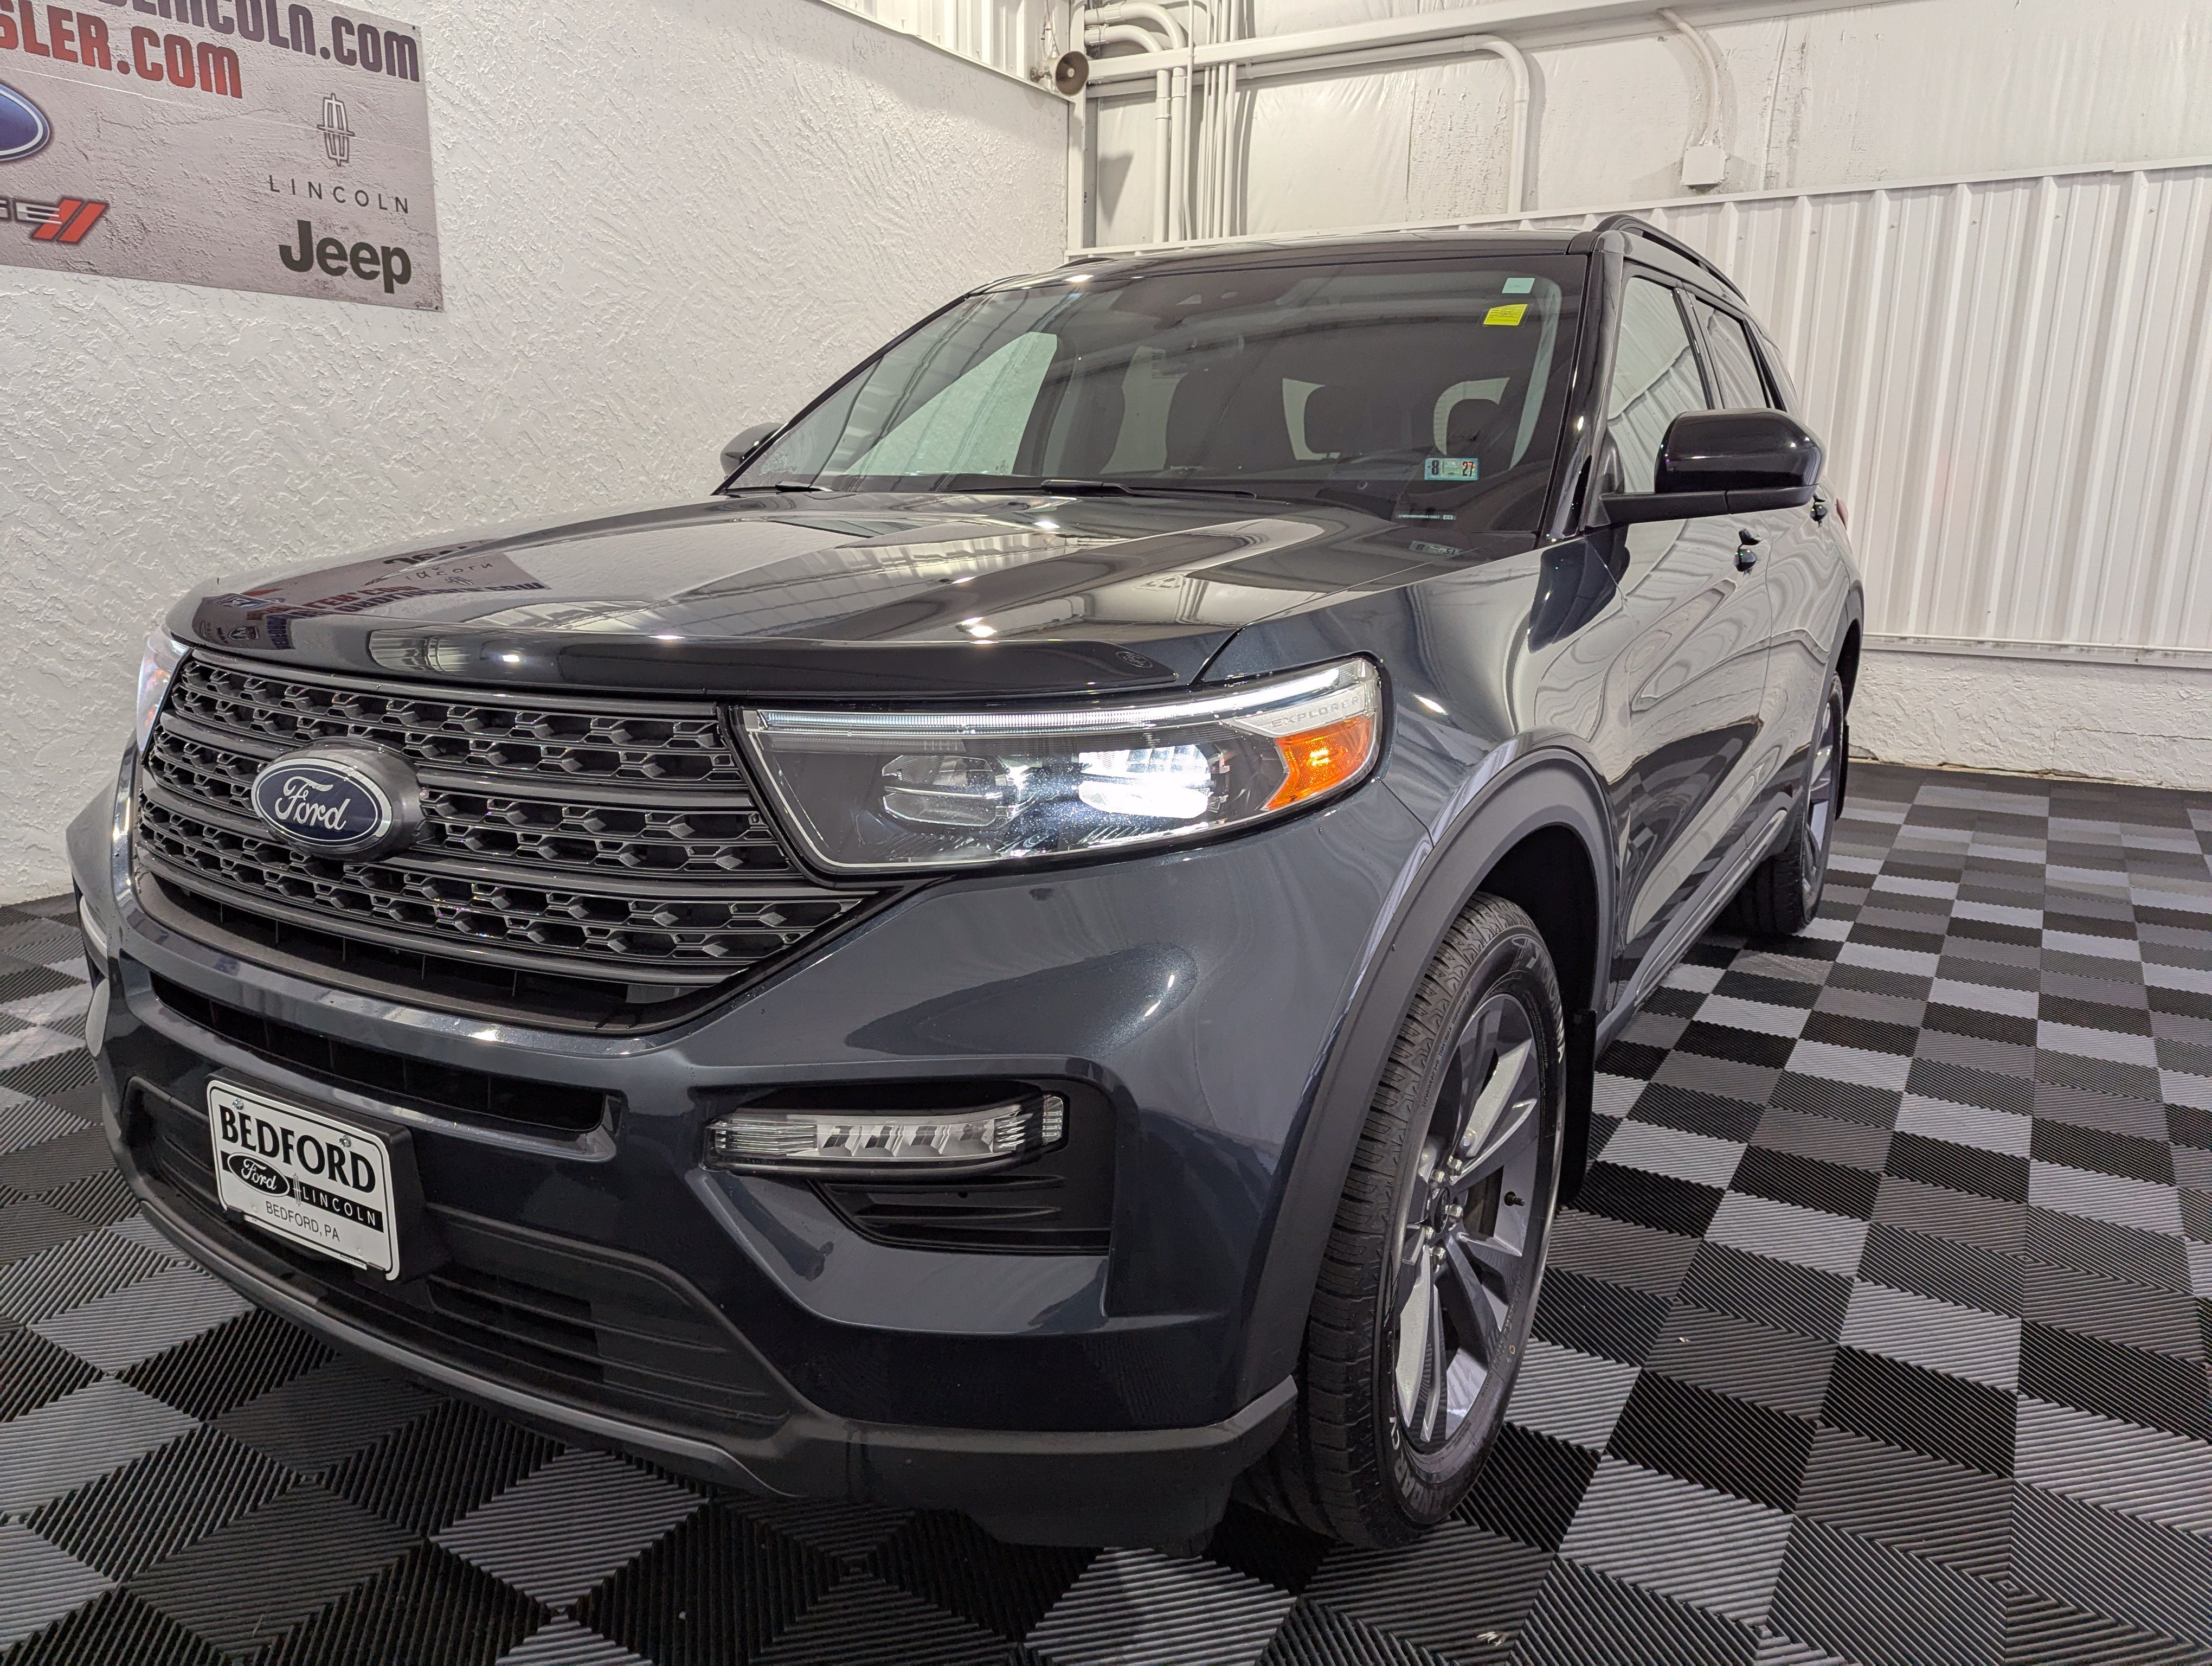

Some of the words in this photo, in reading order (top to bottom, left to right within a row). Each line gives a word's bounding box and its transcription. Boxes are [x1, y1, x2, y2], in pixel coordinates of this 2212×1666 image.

[269, 175, 410, 214] LINCOLN
[279, 219, 411, 294] Jeep
[1431, 460, 1439, 475] 8
[1462, 461, 1474, 477] 27
[1272, 696, 1360, 728] EXPLORER
[275, 776, 351, 831] Ford
[218, 1104, 376, 1193] BEDFORD
[241, 1158, 277, 1190] Ford
[303, 1186, 376, 1226] LINCOLN
[325, 1224, 340, 1242] PA
